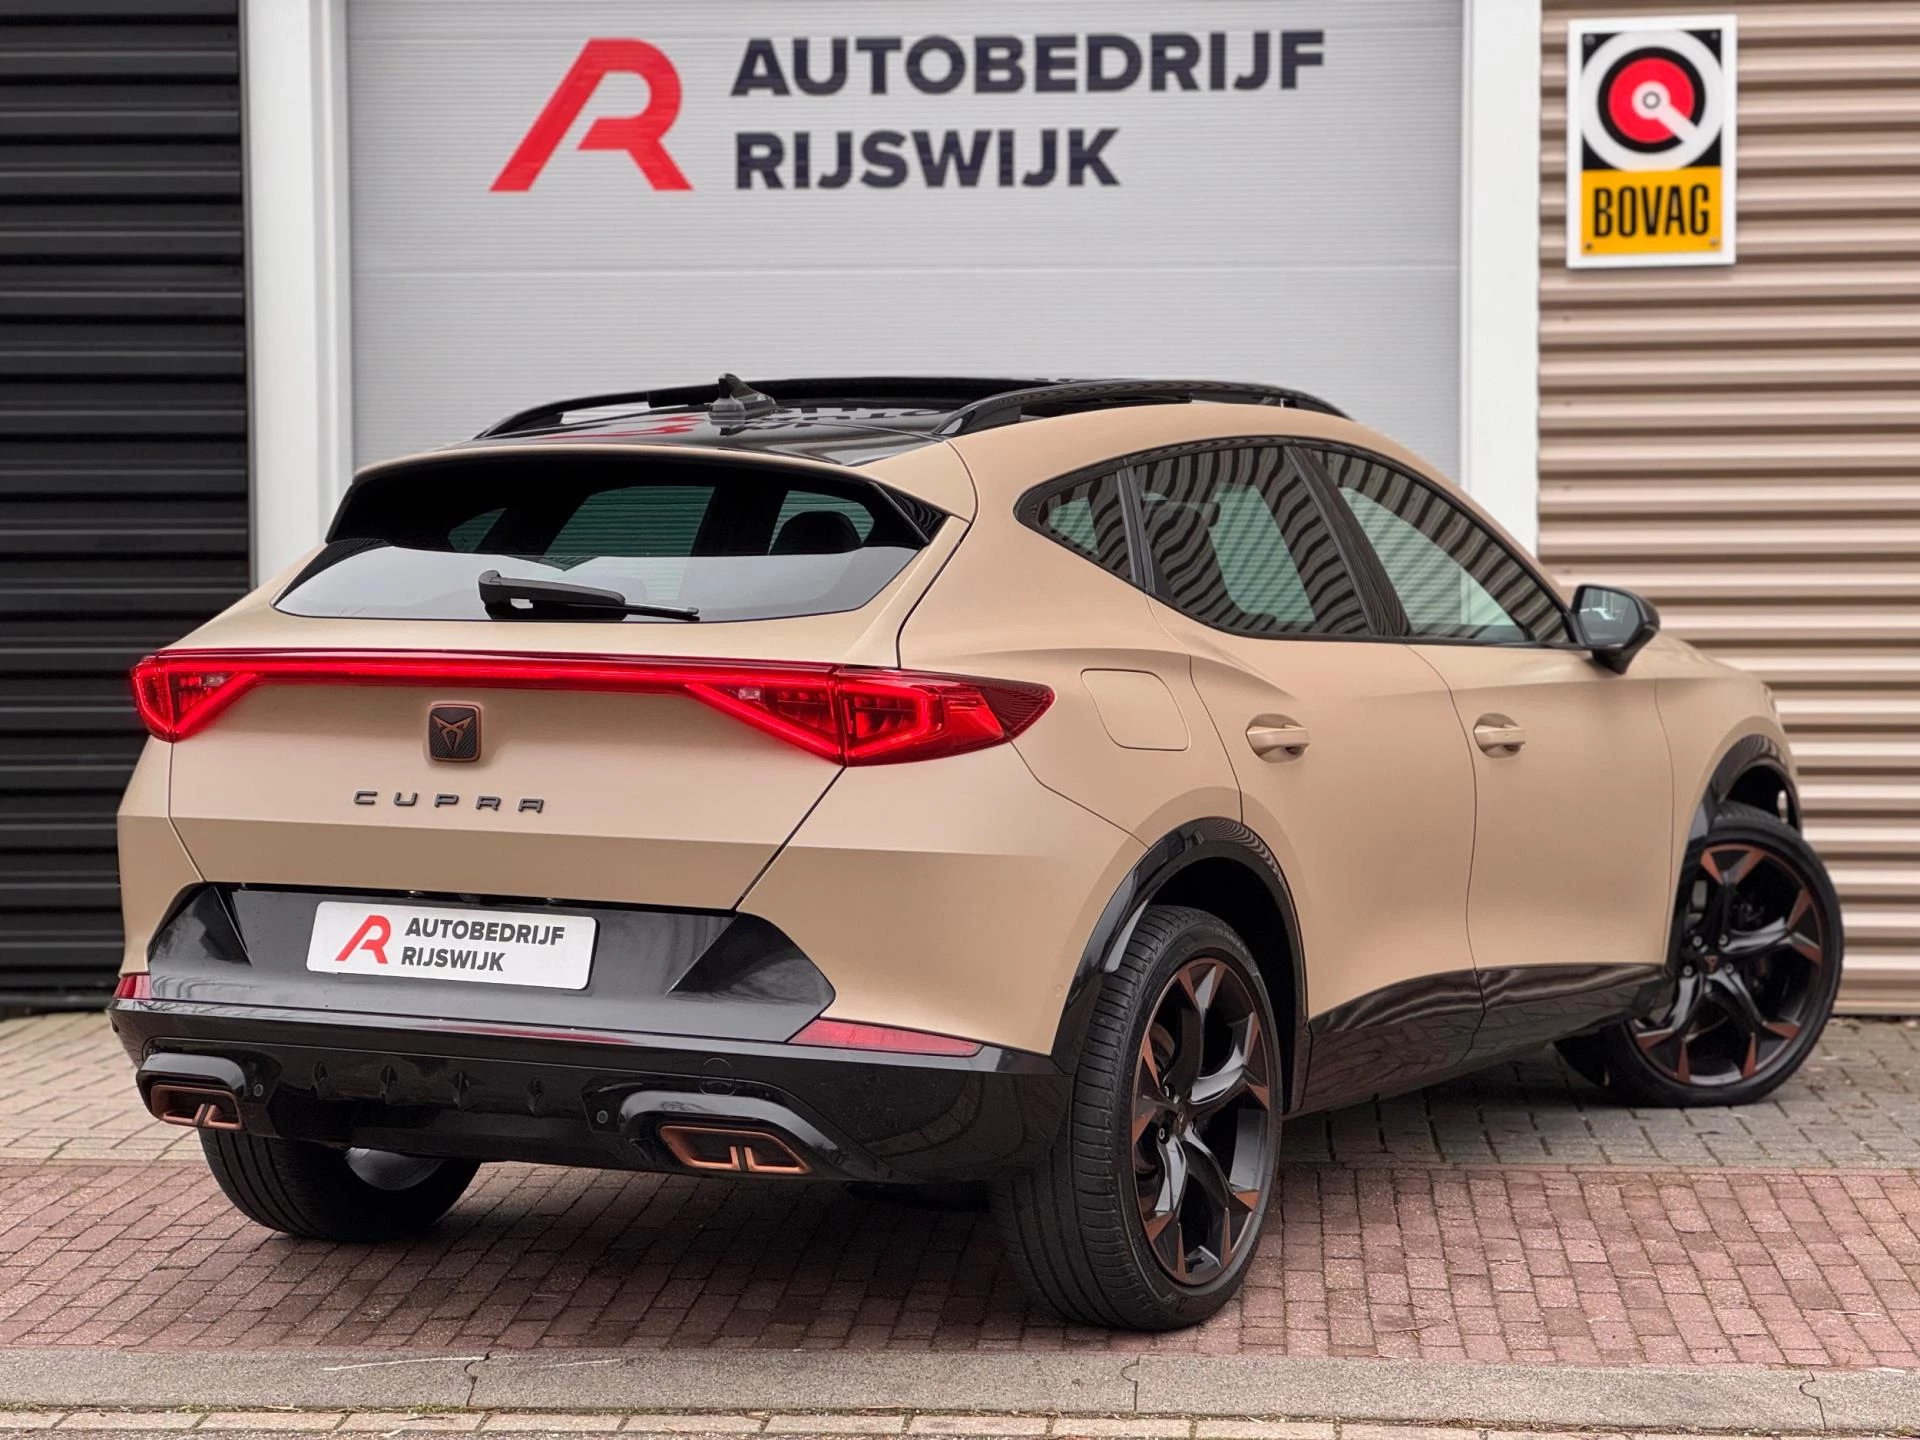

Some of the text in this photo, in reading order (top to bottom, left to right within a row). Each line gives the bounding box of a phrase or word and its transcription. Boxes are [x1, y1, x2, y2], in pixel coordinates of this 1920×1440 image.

[731, 30, 1325, 96] AUTOBEDRIJF
[736, 128, 1121, 190] RIJSWIJK
[1594, 183, 1709, 238] BOVAG
[354, 791, 545, 813] CUPRA
[405, 917, 563, 946] AUTOBEDRIJF
[401, 947, 505, 972] RIJSWIJK
